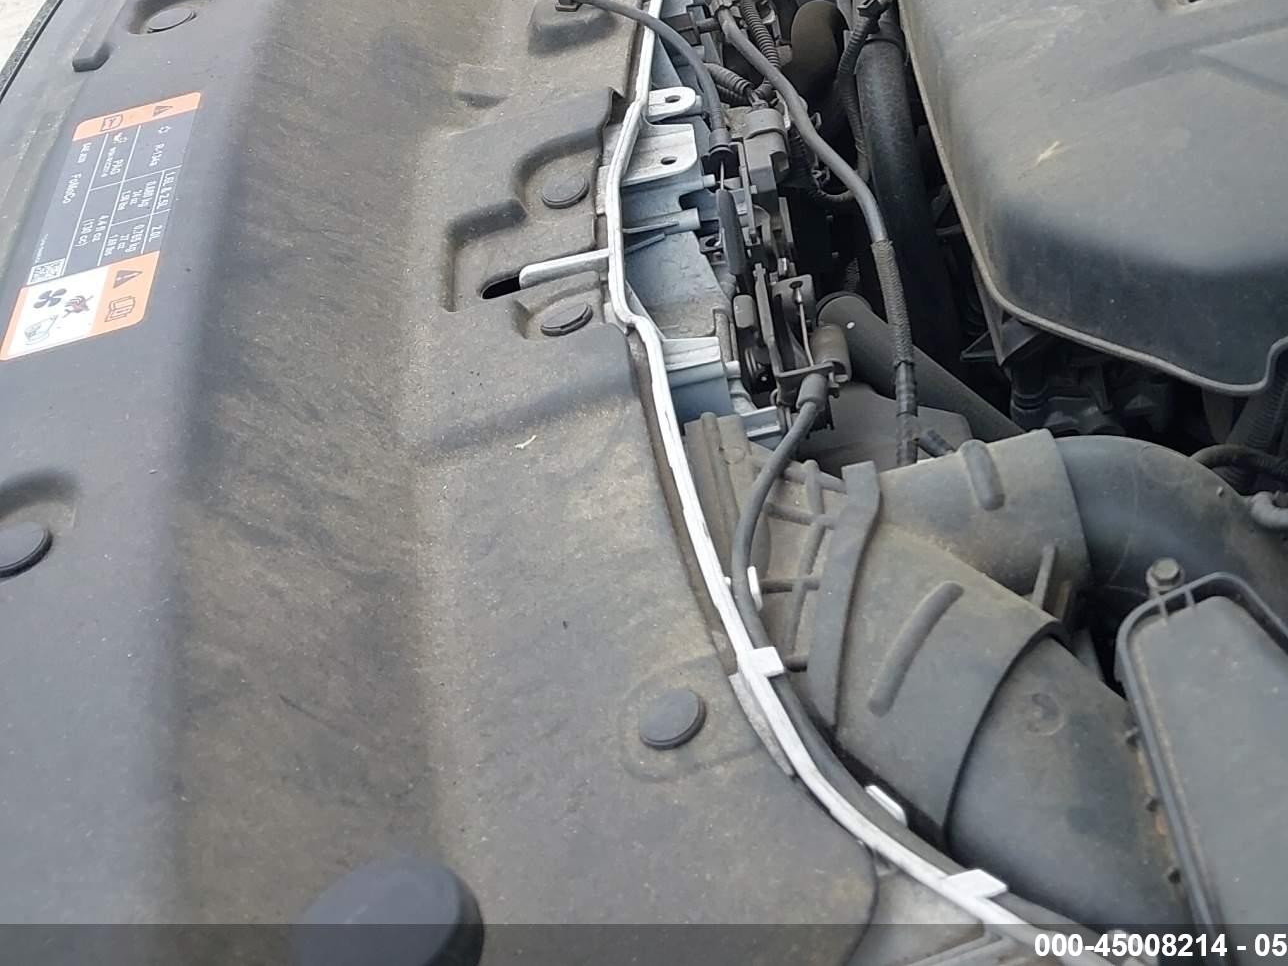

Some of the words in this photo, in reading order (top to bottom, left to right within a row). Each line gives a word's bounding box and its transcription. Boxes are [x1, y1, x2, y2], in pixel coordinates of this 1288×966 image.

[149, 143, 164, 166] R-134a
[110, 159, 123, 175] PAG
[62, 173, 81, 204] FoMoCo
[156, 193, 169, 209] 2.5L
[148, 225, 162, 242] 2.0L
[125, 242, 140, 252] kg
